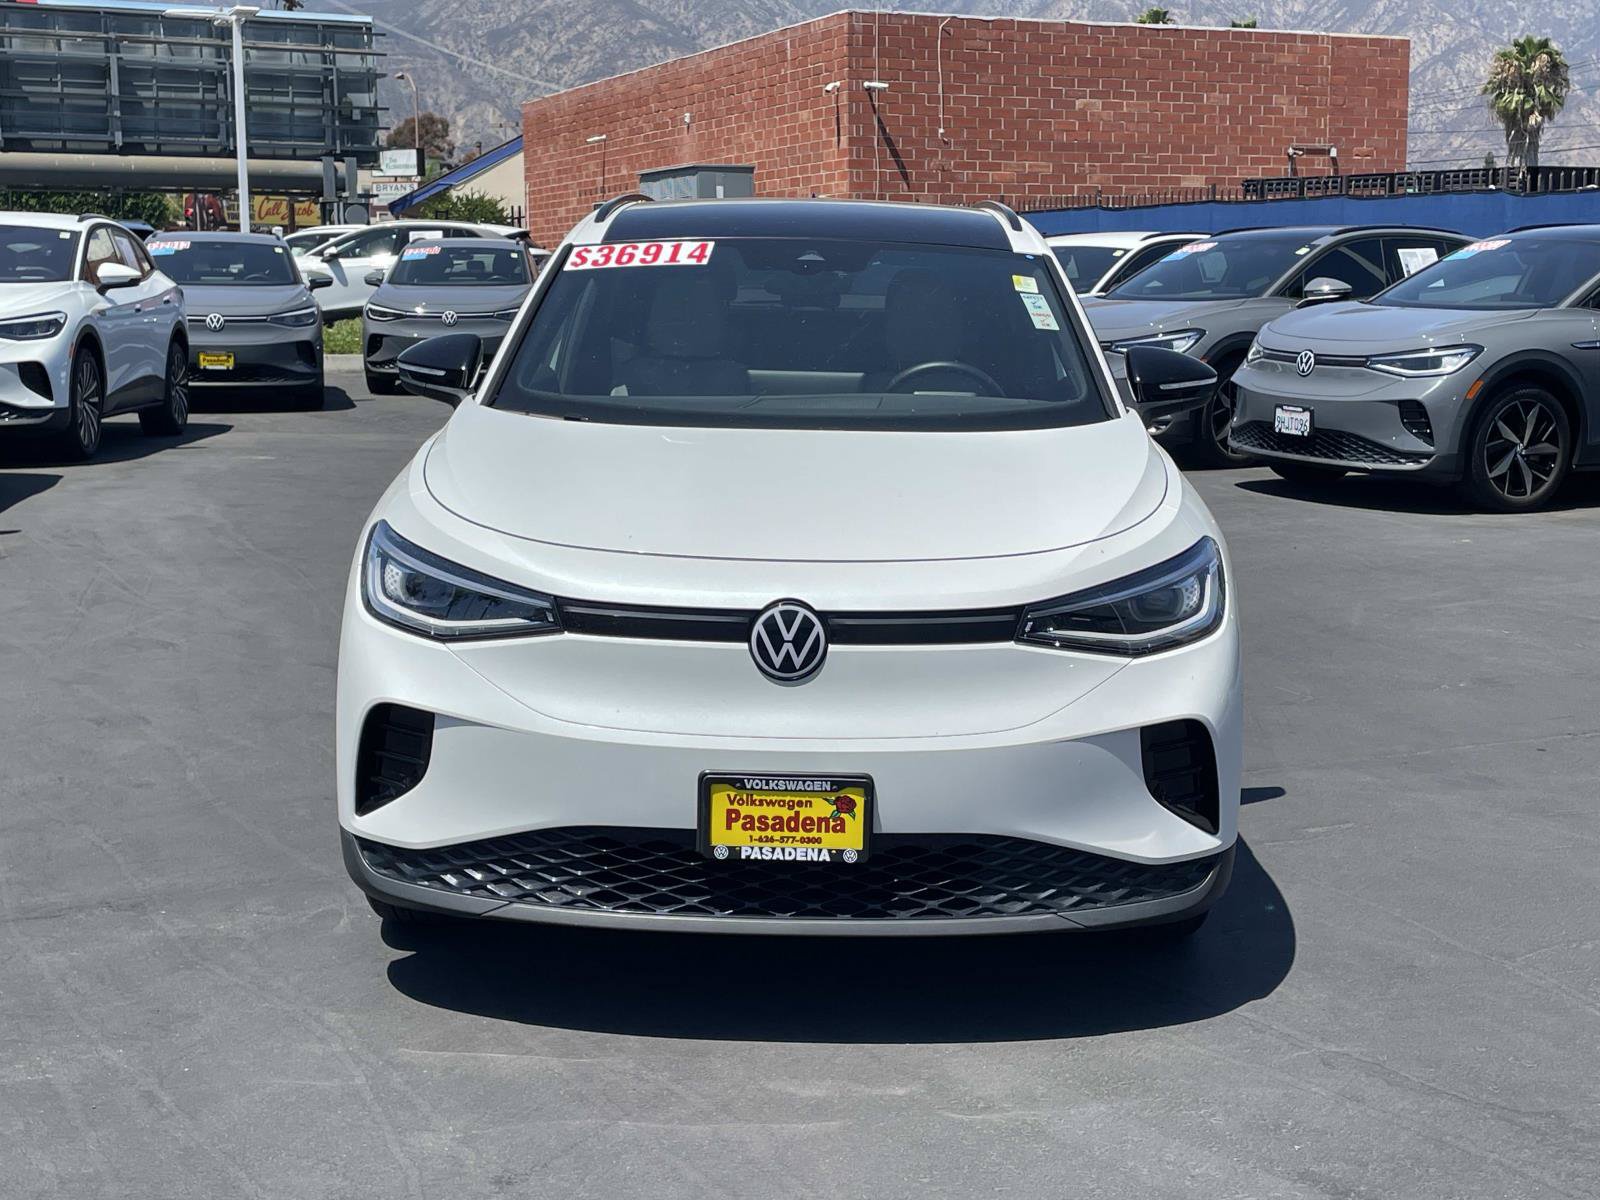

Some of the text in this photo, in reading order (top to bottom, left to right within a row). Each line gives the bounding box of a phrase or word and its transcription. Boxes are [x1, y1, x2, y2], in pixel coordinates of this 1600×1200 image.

[258, 196, 283, 220] Call
[281, 199, 314, 220] Jcob
[570, 243, 709, 267] $36914
[751, 604, 826, 678] VW
[744, 779, 831, 791] VOLKSWAGEN
[726, 794, 813, 810] Volkswagen
[725, 809, 846, 834] Pasadena
[748, 835, 823, 845] 1-626-577-0300
[741, 846, 831, 861] PASADENA
